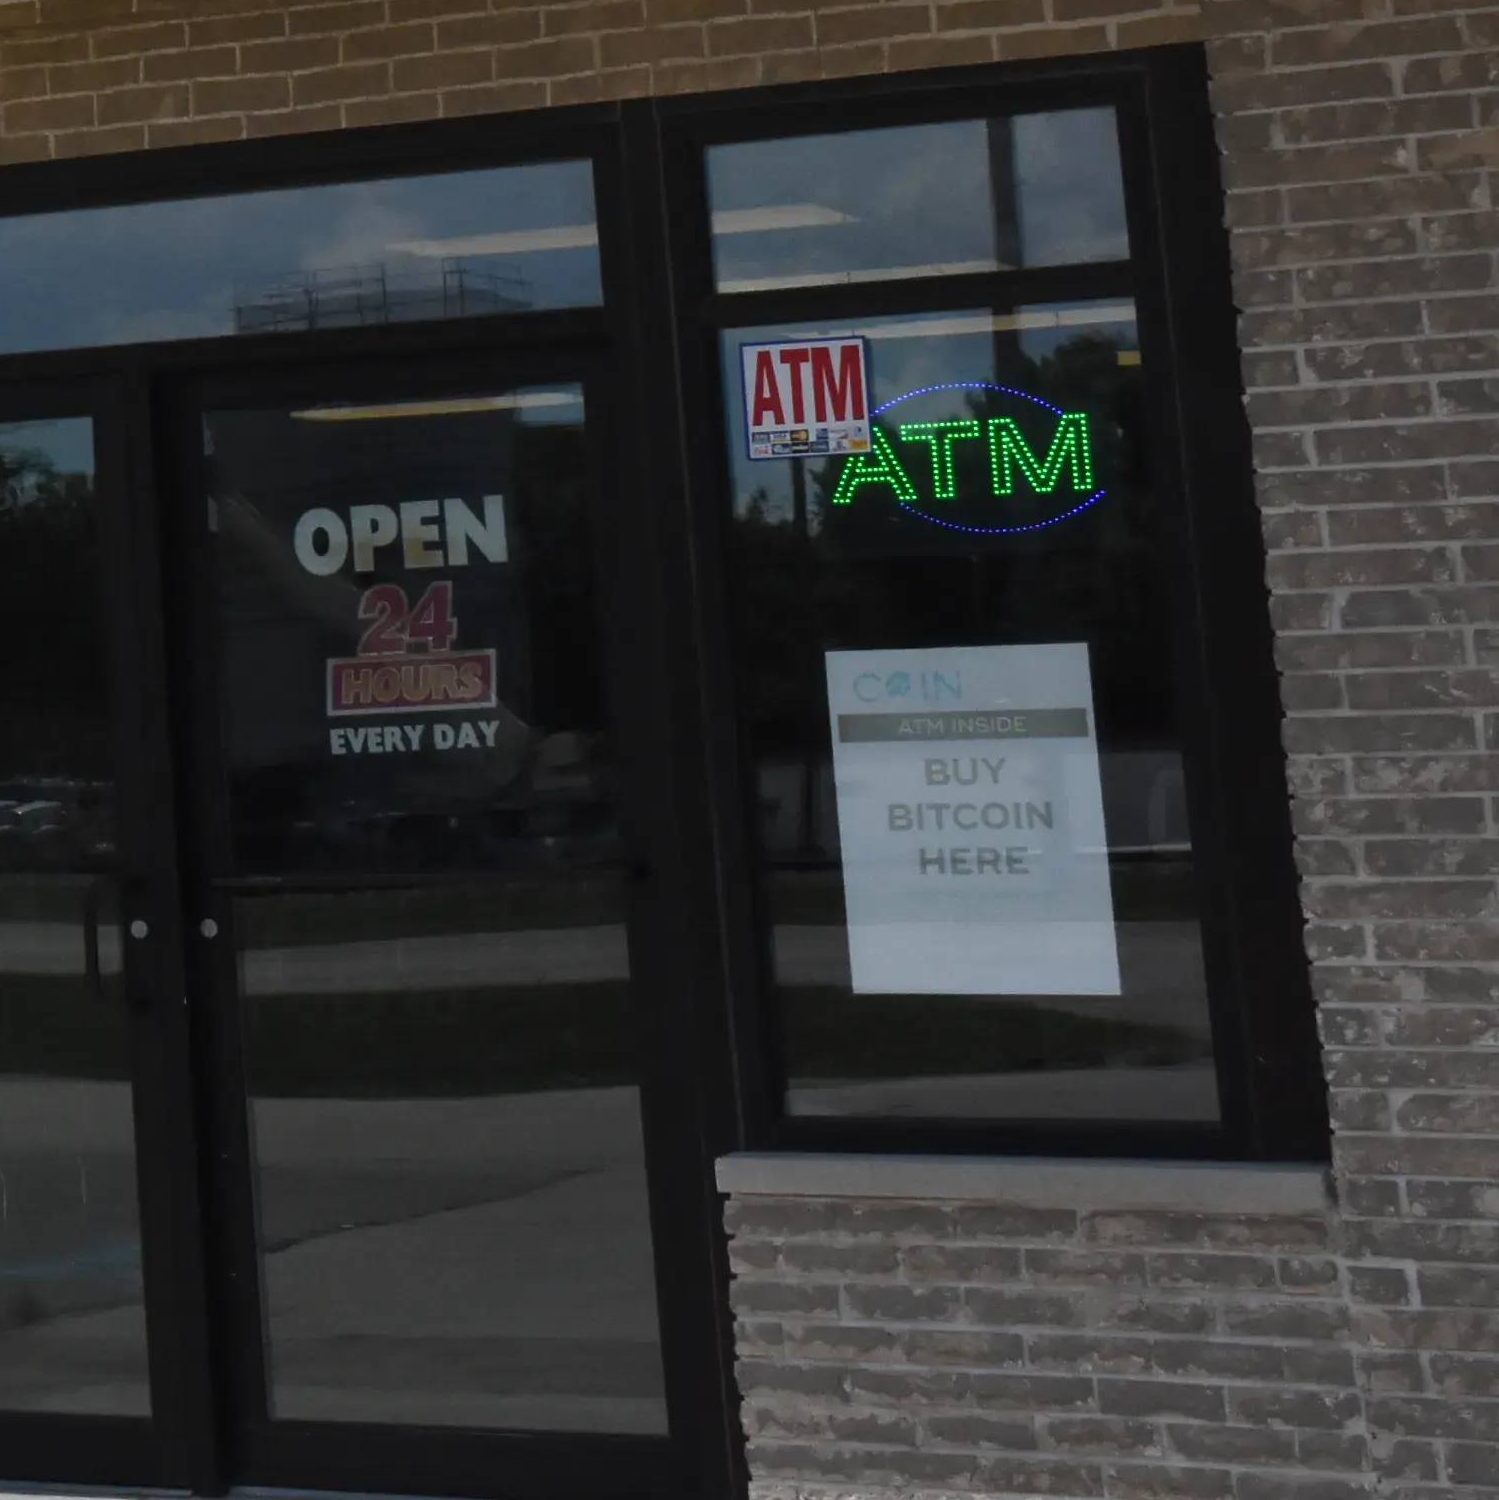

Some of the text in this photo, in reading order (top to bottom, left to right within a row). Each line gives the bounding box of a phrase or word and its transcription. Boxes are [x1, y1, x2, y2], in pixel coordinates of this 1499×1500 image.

[752, 345, 864, 426] ATM
[832, 412, 1094, 505] ATM
[293, 494, 508, 576] OPEN
[356, 580, 458, 657] 24
[341, 663, 483, 705] HOURS
[852, 669, 964, 703] COIN
[329, 720, 500, 755] EVERY DAY
[897, 715, 1028, 736] ATM INSIDE
[923, 757, 1007, 787] BUY
[887, 800, 1055, 833] BITCOIN
[918, 846, 1032, 876] HERE
